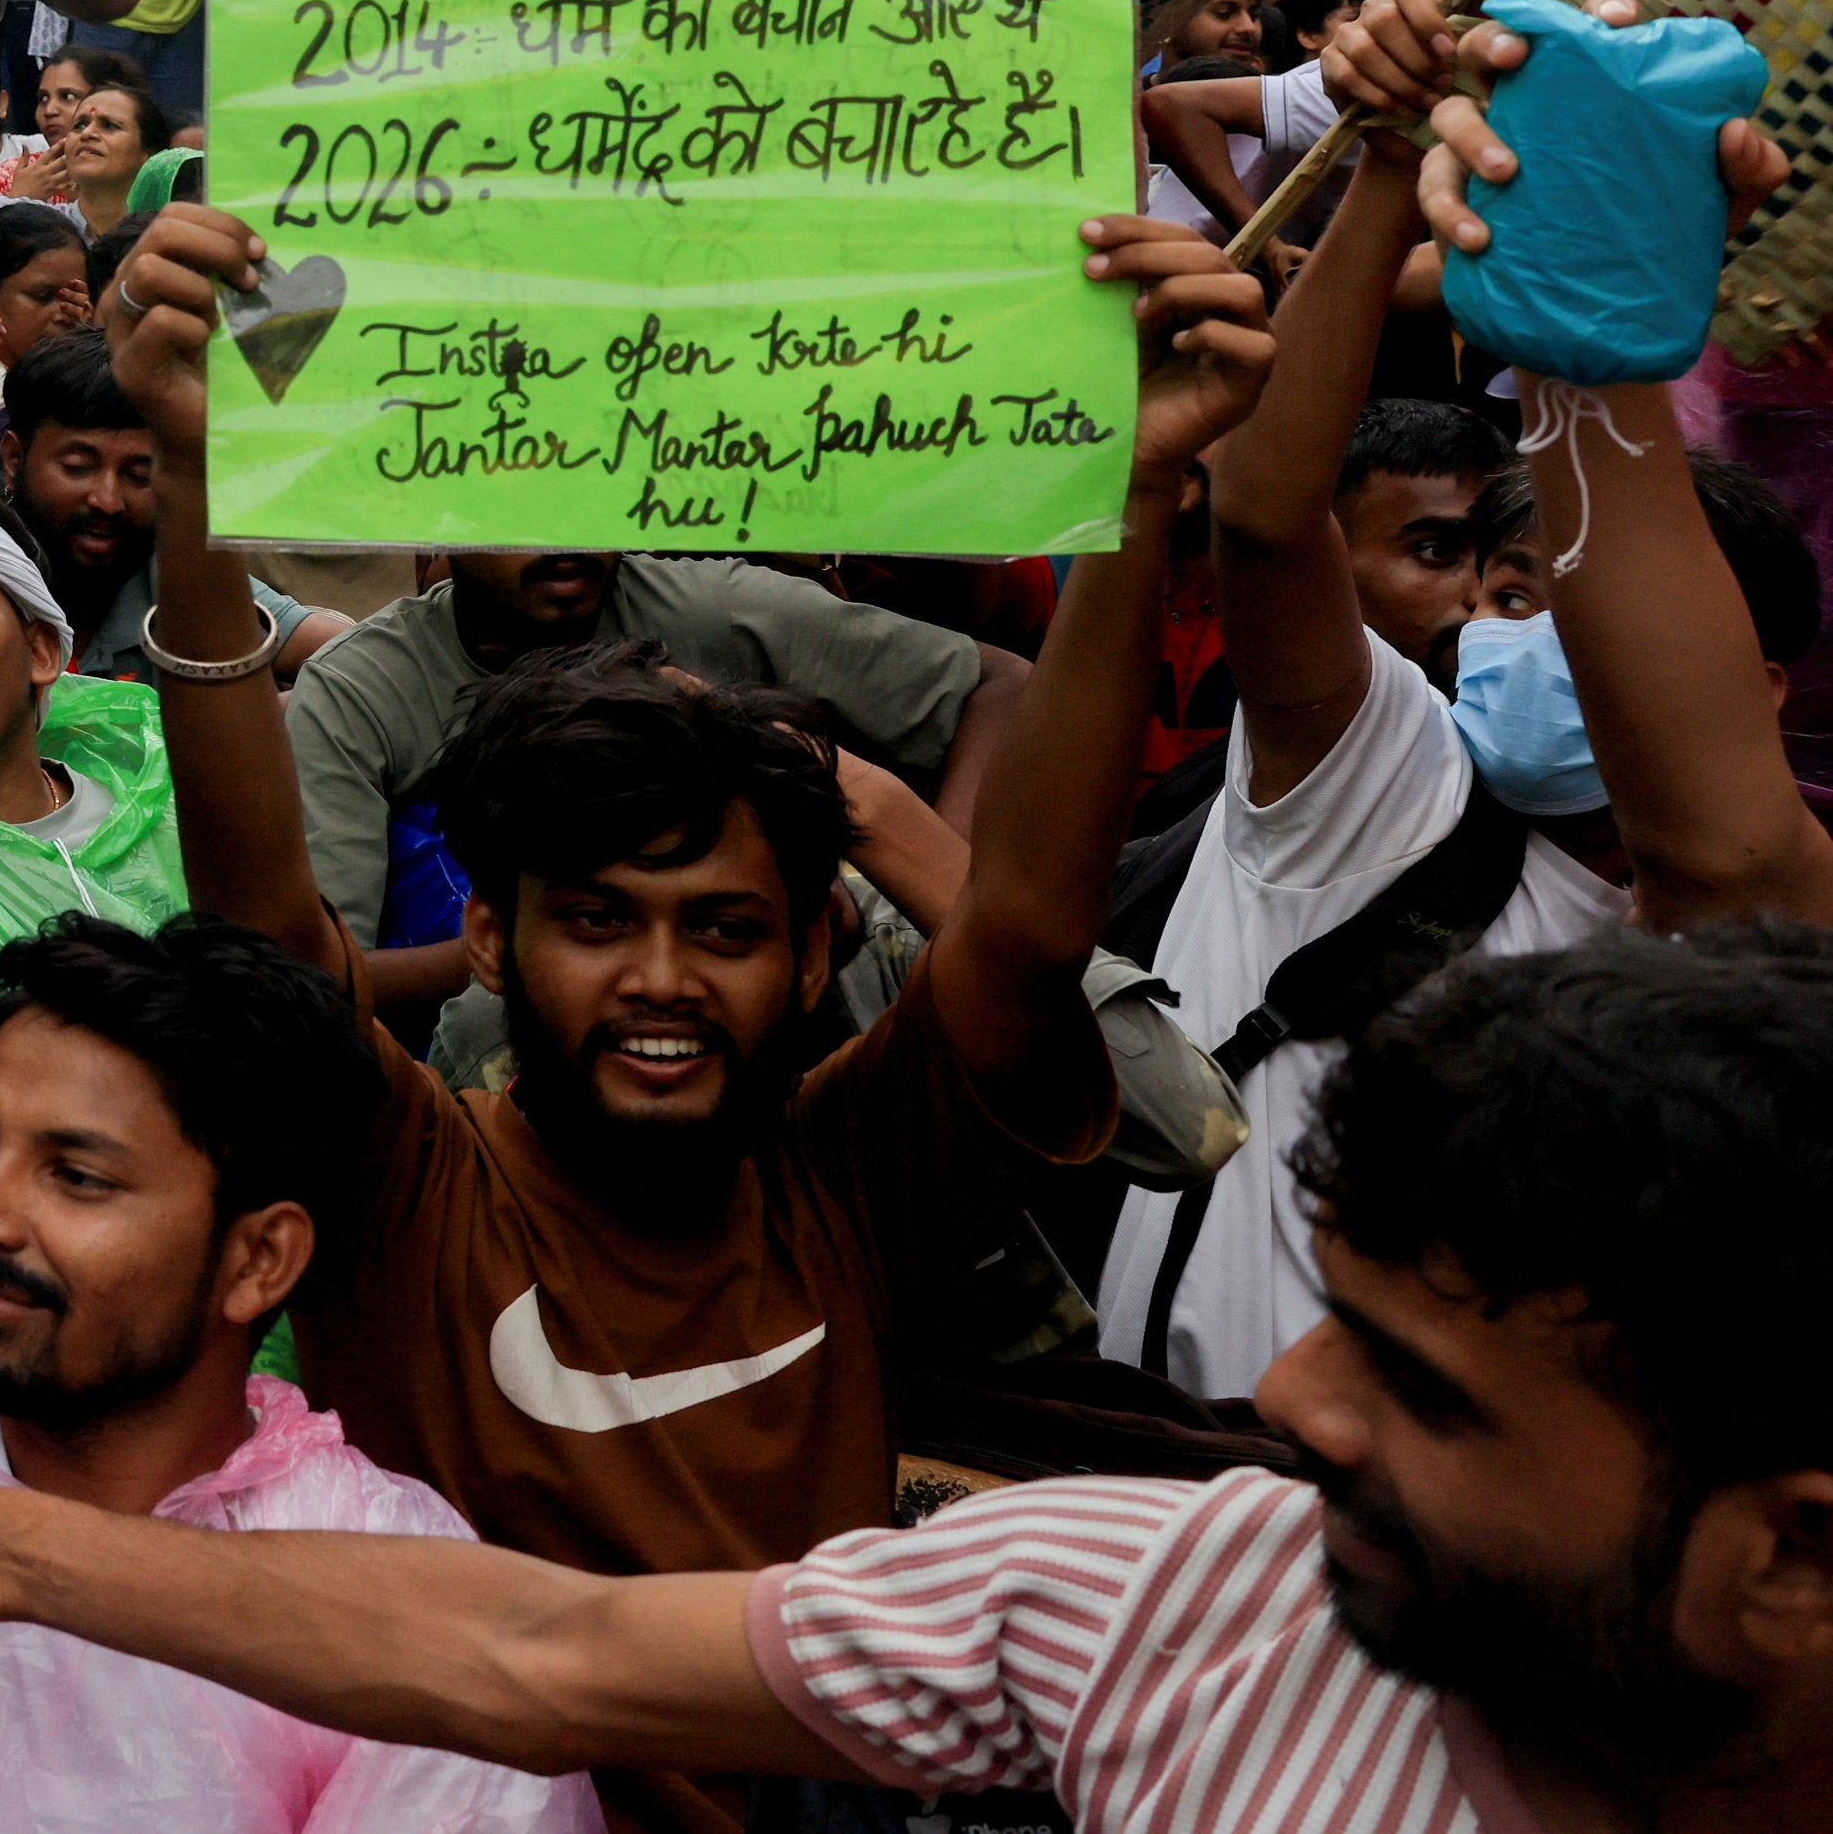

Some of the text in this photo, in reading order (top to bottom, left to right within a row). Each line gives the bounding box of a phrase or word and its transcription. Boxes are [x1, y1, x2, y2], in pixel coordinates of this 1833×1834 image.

[680, 70, 785, 177] को
[880, 306, 974, 364] hi
[375, 396, 601, 484] Jantar
[601, 406, 803, 476] Mantar
